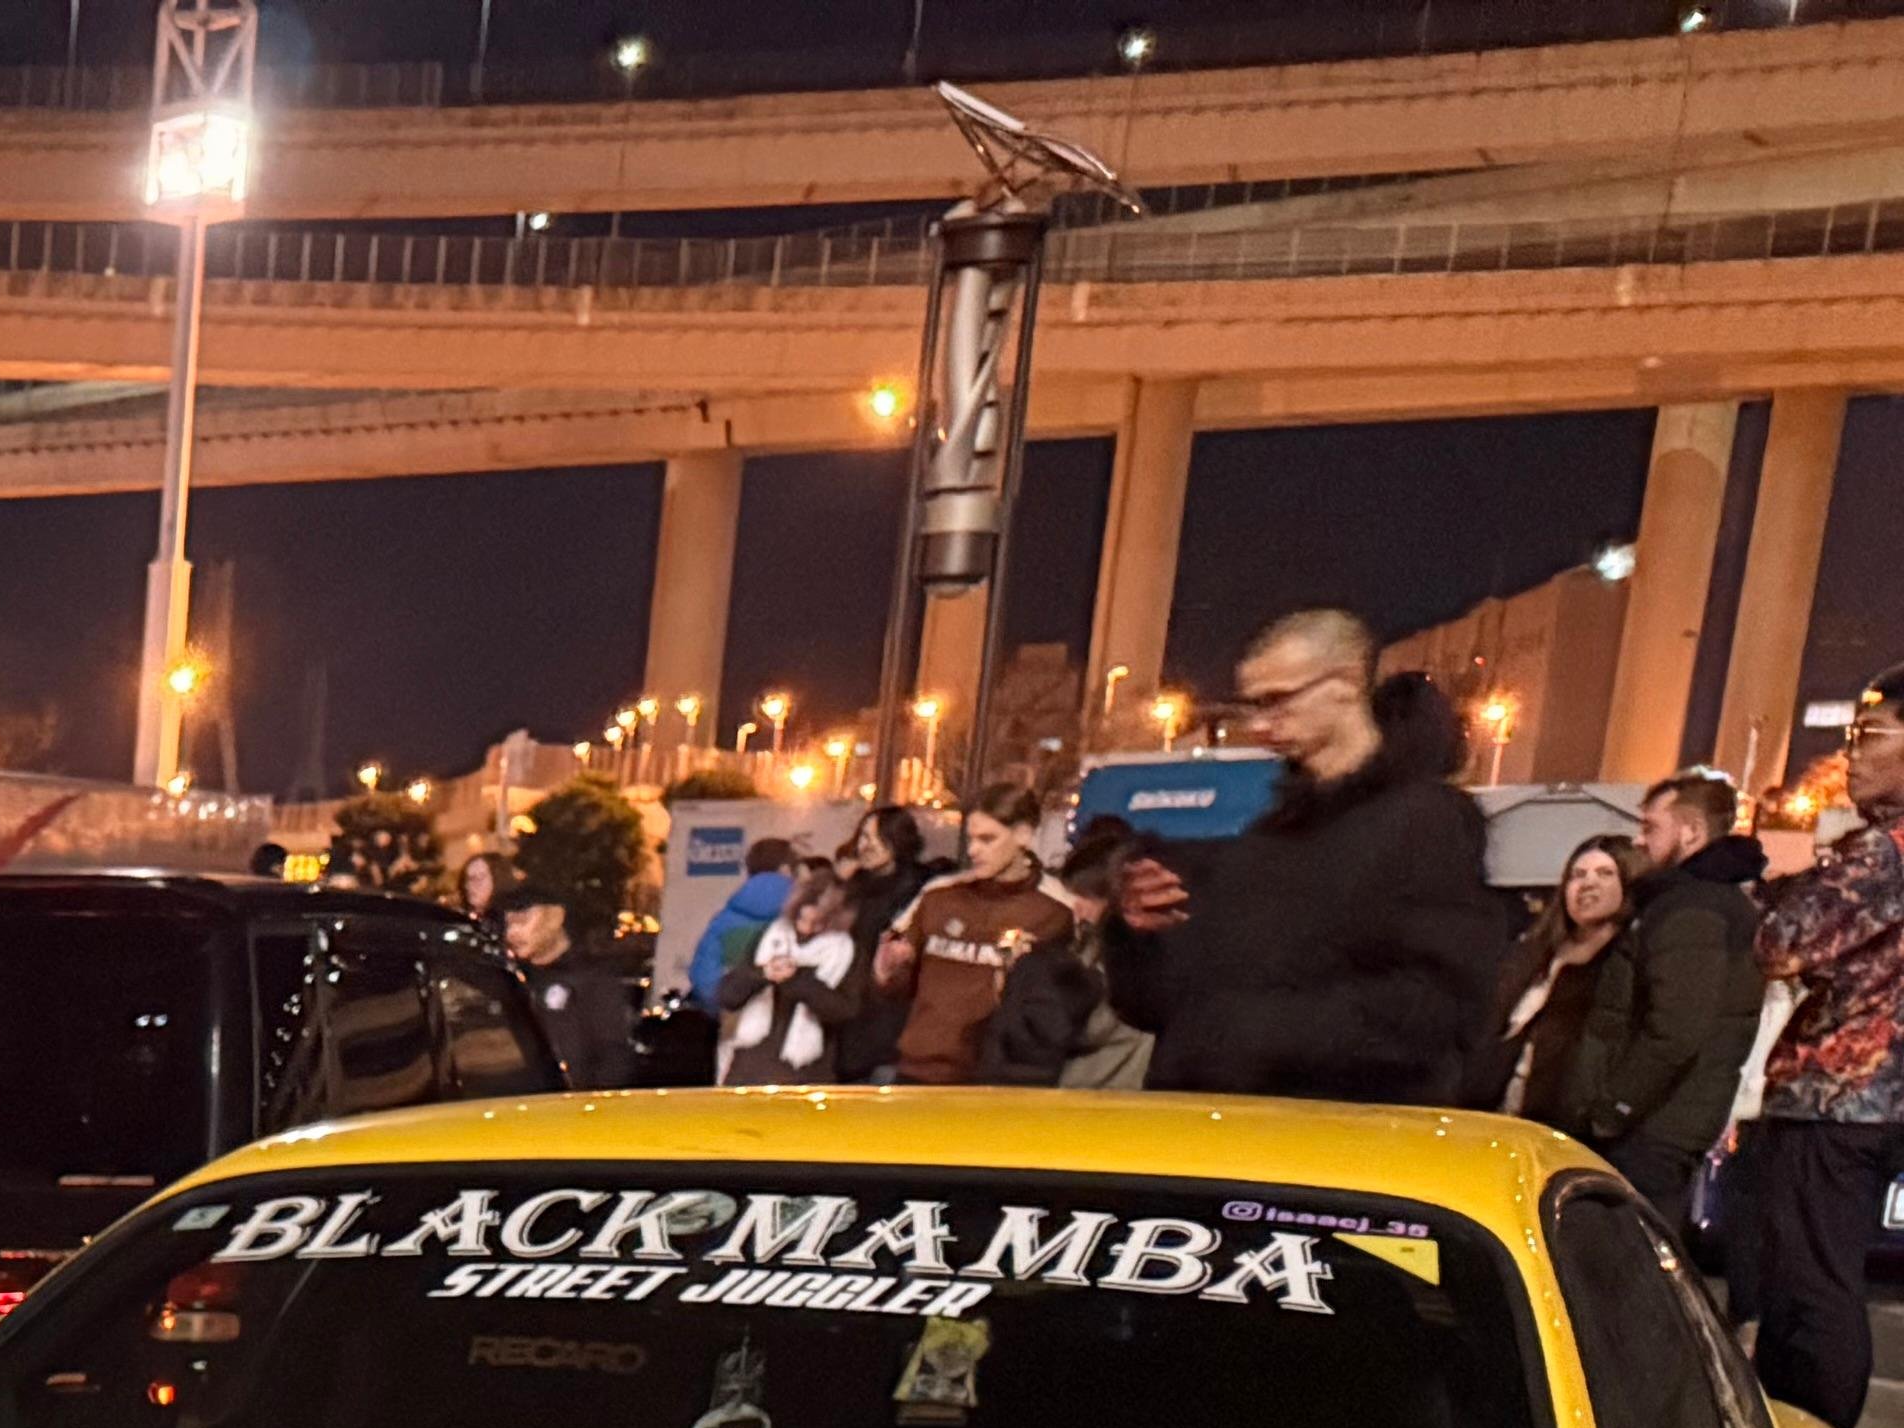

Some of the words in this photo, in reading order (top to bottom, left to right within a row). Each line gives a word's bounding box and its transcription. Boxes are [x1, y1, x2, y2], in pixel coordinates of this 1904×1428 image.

[427, 1263, 688, 1301] STREET
[679, 1268, 993, 1318] JUGGLER
[467, 1335, 644, 1374] RECARO
